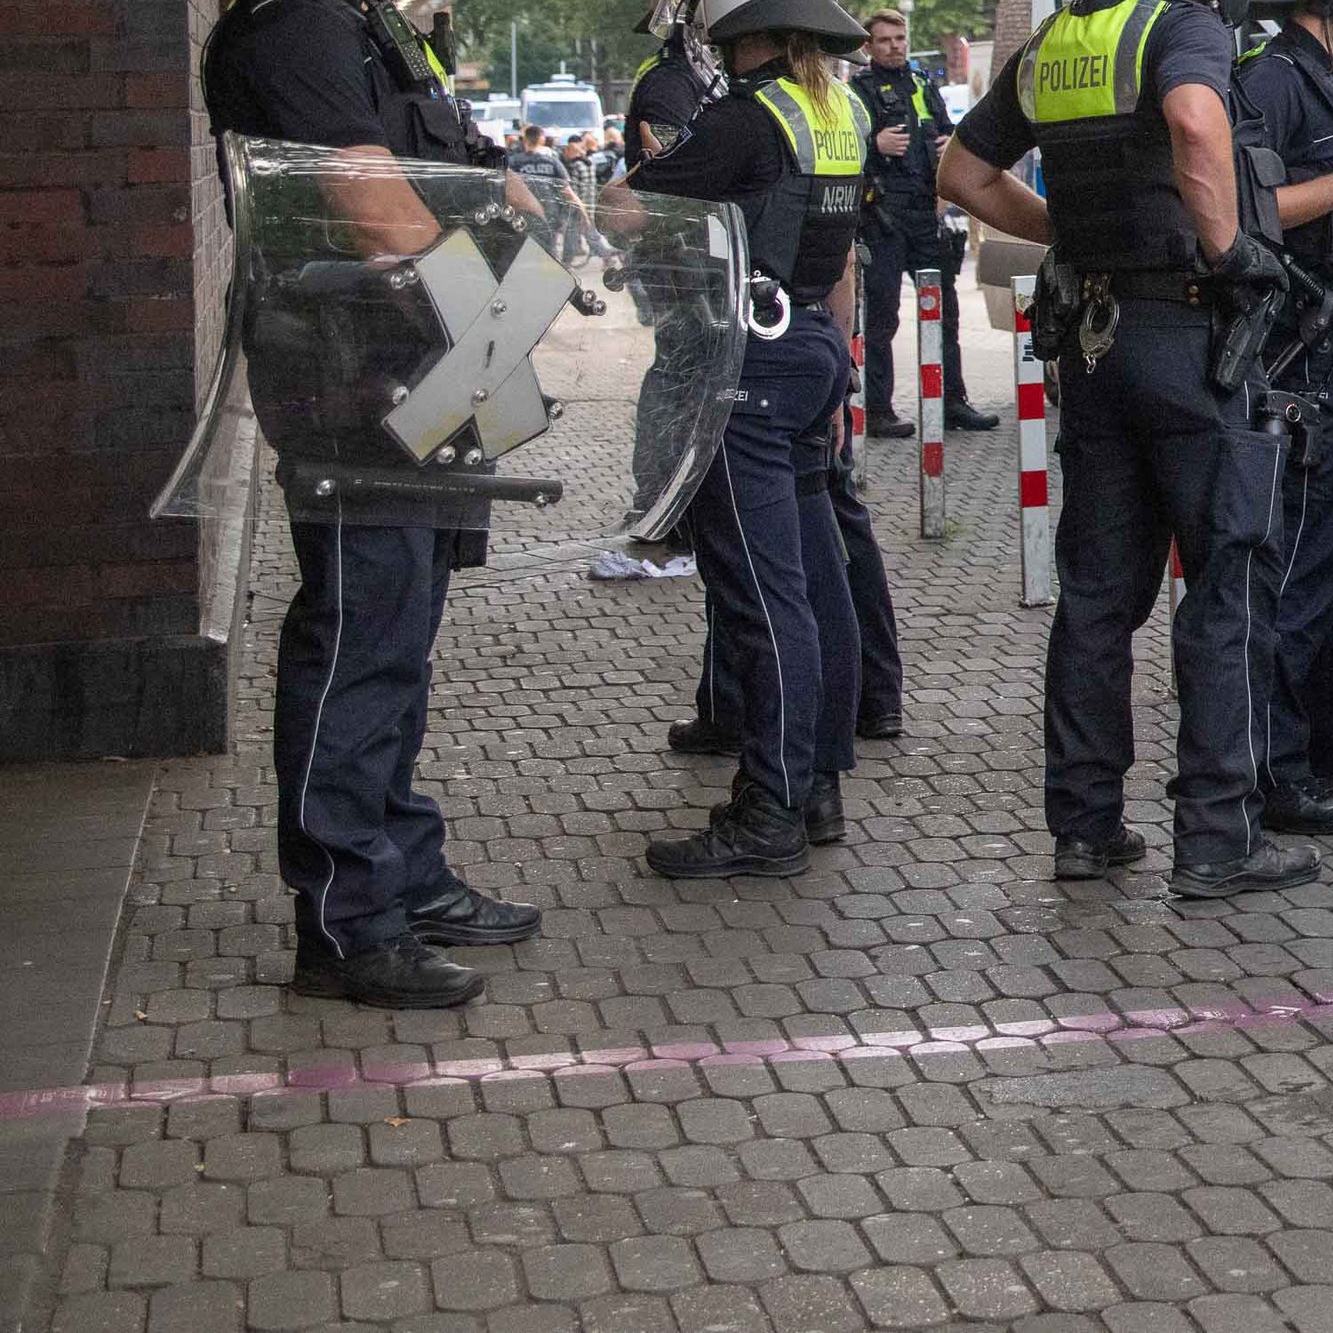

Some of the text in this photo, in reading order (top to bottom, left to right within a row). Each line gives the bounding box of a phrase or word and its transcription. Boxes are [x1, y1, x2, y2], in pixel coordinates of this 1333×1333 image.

[1040, 54, 1108, 94] POLIZEI
[813, 130, 859, 161] POLIZEI
[821, 185, 857, 213] NRW
